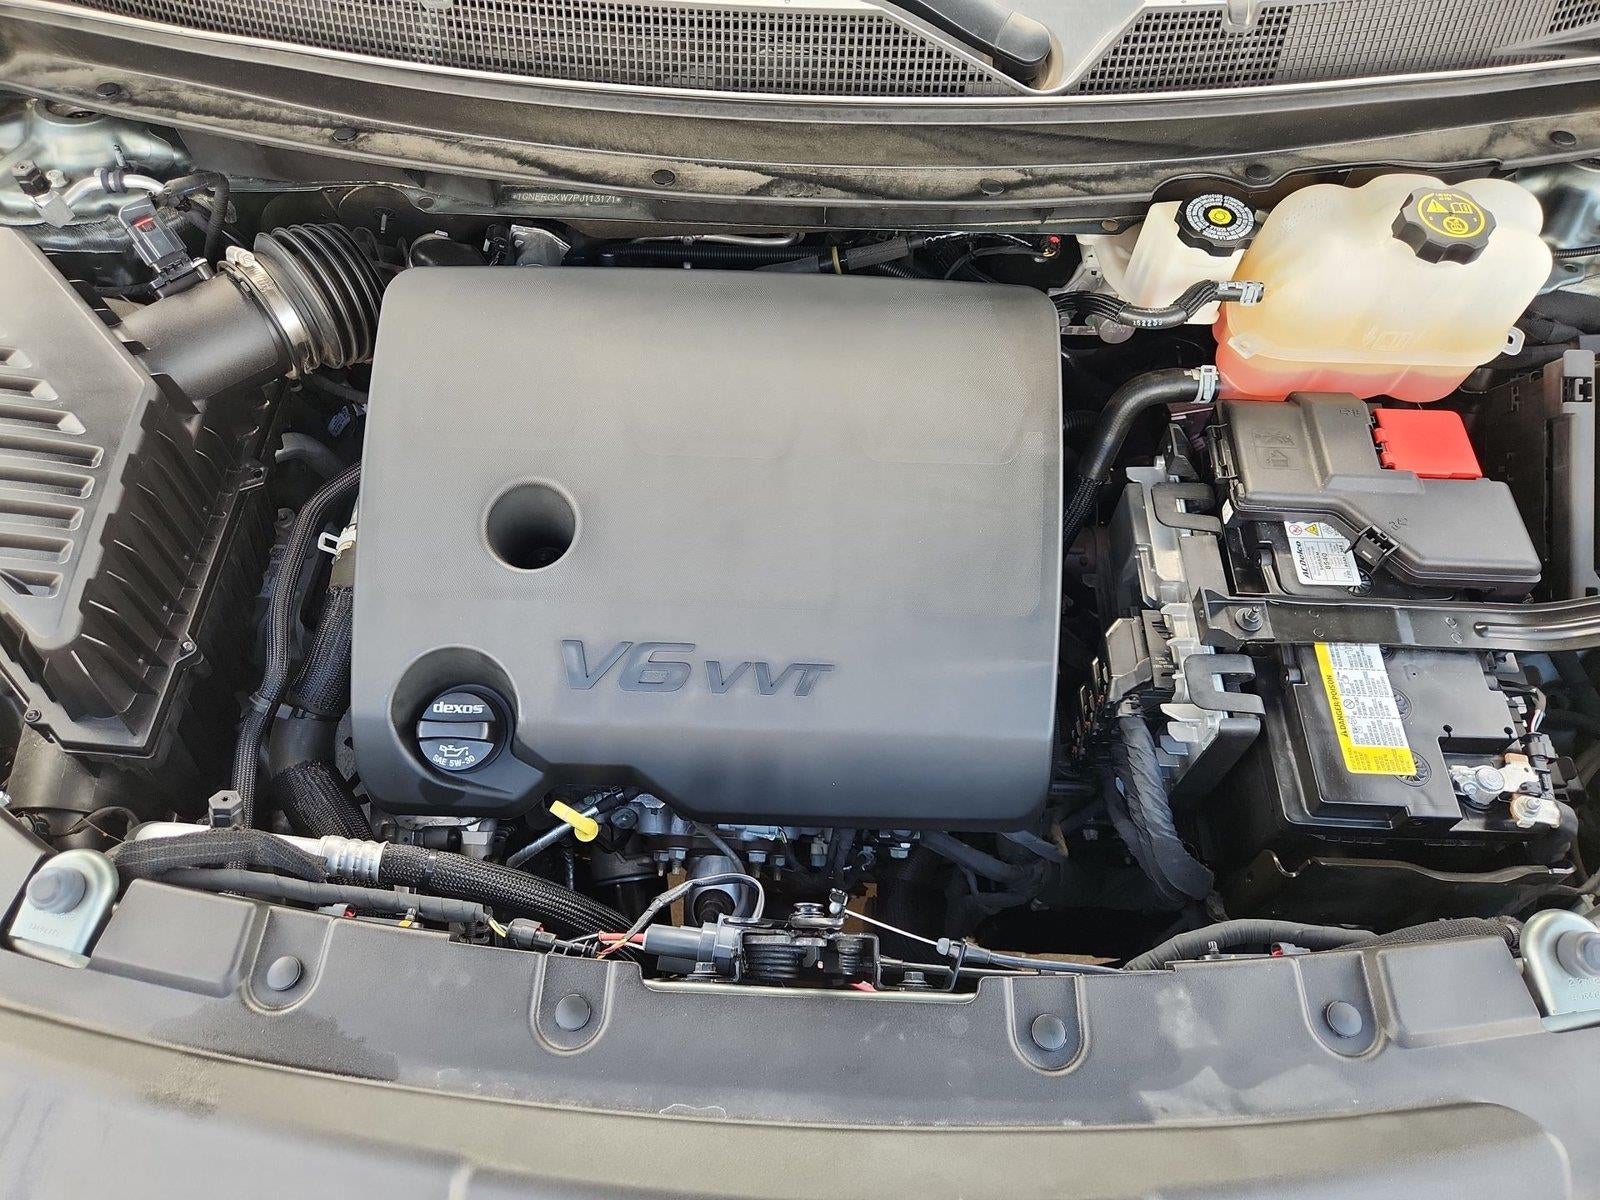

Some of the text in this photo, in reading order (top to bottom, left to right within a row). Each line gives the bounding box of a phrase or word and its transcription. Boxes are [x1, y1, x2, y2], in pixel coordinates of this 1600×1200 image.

[1296, 540, 1310, 579] ACDelco
[561, 639, 835, 697] V6 VVT
[432, 701, 485, 714] dexos
[432, 754, 475, 767] SAE 5W-30
